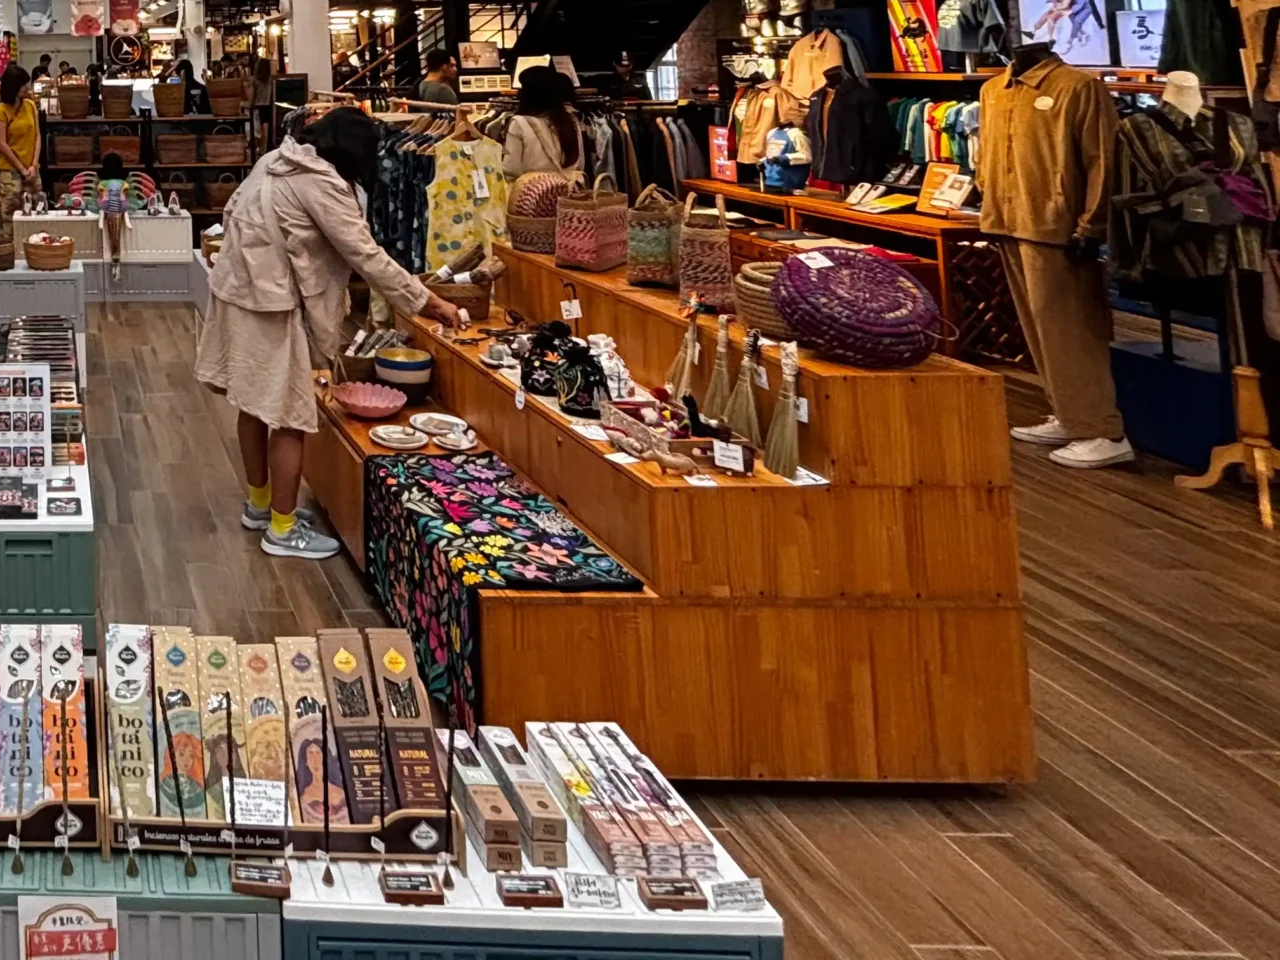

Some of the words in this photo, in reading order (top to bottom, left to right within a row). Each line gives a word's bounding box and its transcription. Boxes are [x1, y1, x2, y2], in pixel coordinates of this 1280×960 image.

[118, 714, 143, 729] bo
[122, 730, 140, 745] tá
[121, 748, 142, 761] ni
[349, 749, 378, 759] NATURAL
[399, 750, 429, 759] NATURAL
[120, 765, 144, 778] co
[245, 834, 255, 844] de
[255, 835, 280, 847] frutas
